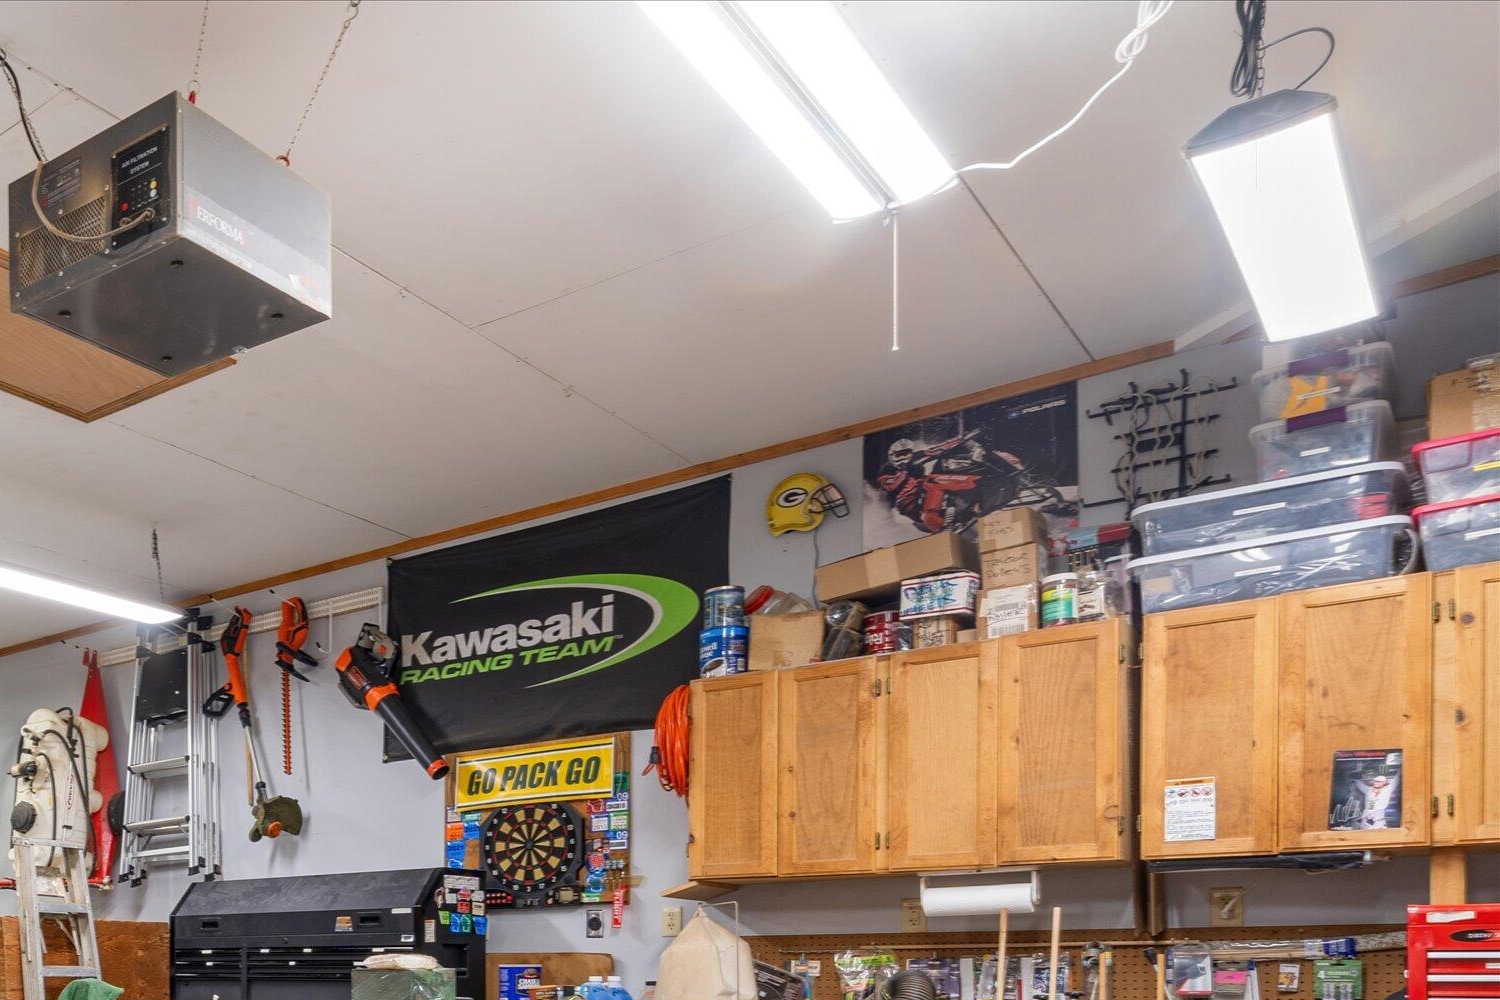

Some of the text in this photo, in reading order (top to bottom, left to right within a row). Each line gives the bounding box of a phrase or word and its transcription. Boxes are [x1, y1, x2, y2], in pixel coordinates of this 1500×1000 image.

[130, 146, 158, 163] FILTRATION
[130, 161, 150, 174] SYSTEM
[401, 593, 615, 667] Kawasaki
[399, 652, 515, 685] RACING
[521, 635, 616, 661] TEAM
[467, 756, 601, 796] GO PACK GO
